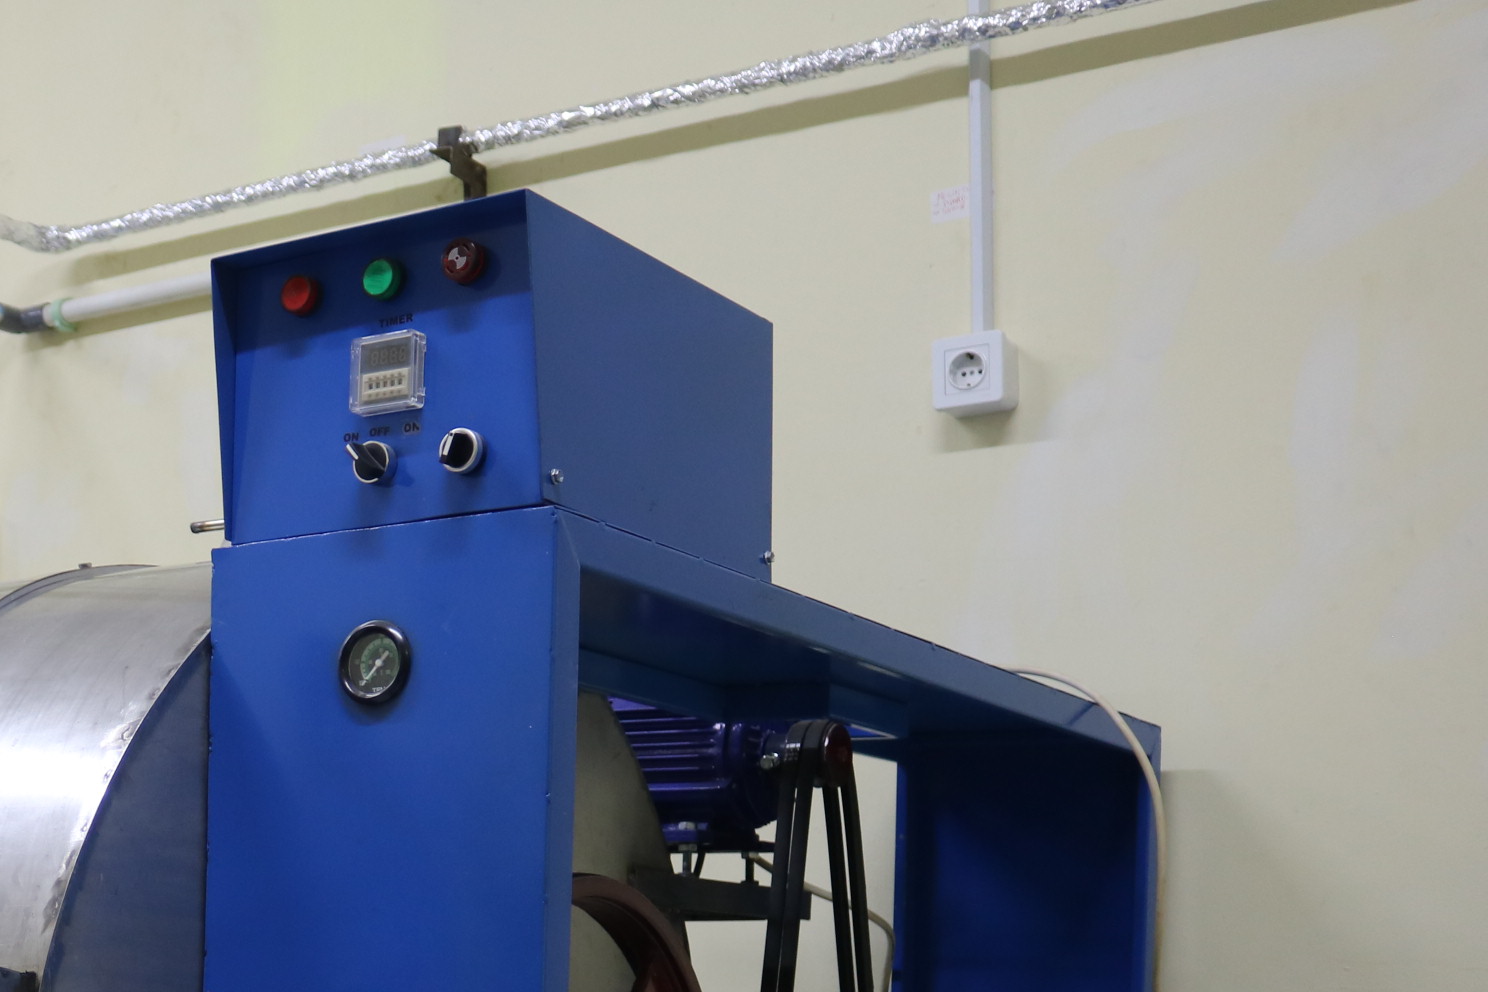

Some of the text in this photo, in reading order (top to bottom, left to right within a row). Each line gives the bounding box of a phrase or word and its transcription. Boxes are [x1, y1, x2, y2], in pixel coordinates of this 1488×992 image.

[379, 313, 413, 328] TIMER
[343, 422, 420, 442] ON OFF ON
